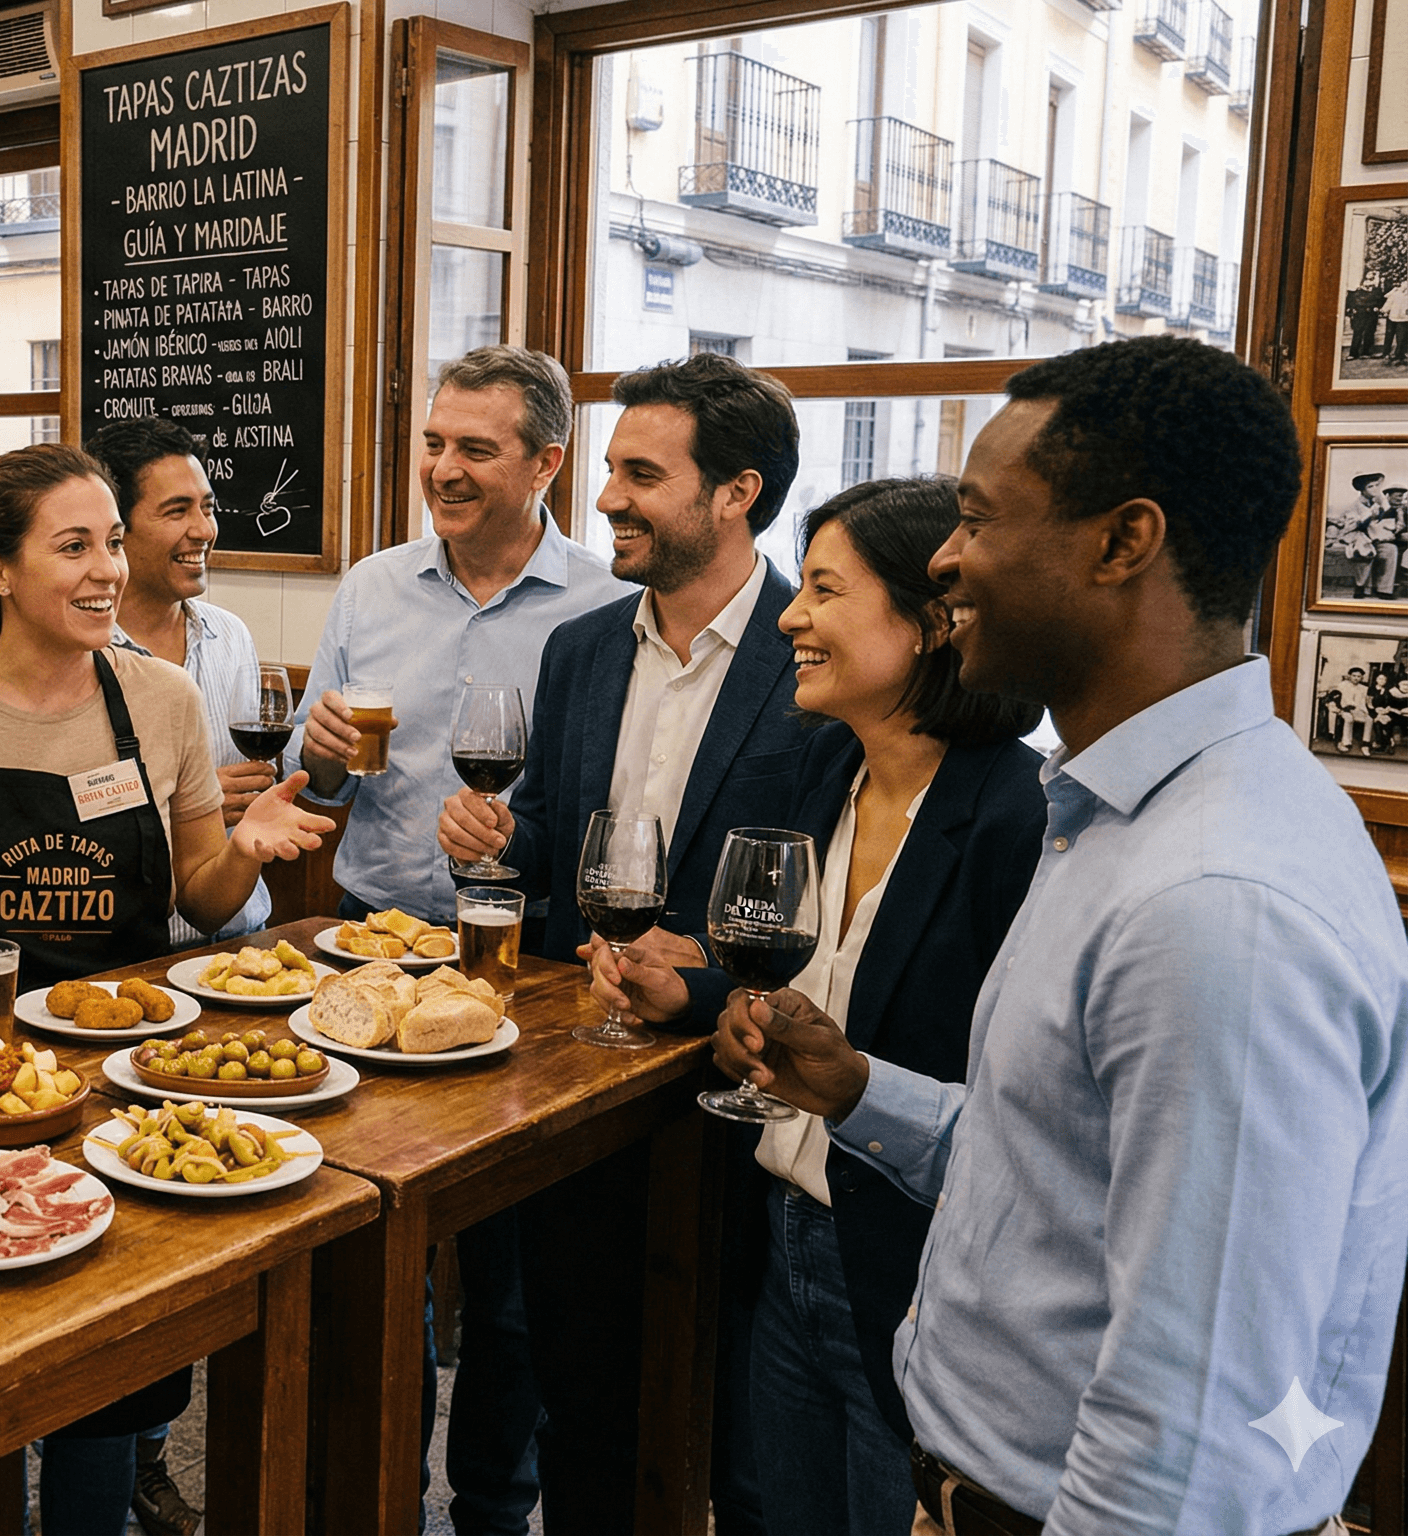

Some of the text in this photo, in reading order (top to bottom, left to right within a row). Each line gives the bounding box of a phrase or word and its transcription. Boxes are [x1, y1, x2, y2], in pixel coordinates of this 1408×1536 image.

[103, 50, 308, 124] TAPAS CAZTIZAS
[150, 114, 258, 173] MADRID
[125, 167, 289, 215] BARRIO LA LATINA
[123, 212, 288, 259] GUÍA Y MARIDAJE
[102, 263, 291, 301] TAPAS DE TAPIRA TAPAS
[103, 306, 150, 331] PINATA
[154, 304, 172, 327] DE
[262, 293, 313, 319] BARRO
[103, 331, 150, 360] JAMÓN
[155, 328, 208, 357] IBÉRICO
[103, 366, 158, 390] PATATAS
[161, 363, 213, 387] BRAVAS
[263, 358, 304, 382] BRALI
[1, 833, 114, 868] RUTA DE TAPAS
[26, 866, 90, 886] MADRID
[0, 889, 115, 922] CAZTIZO
